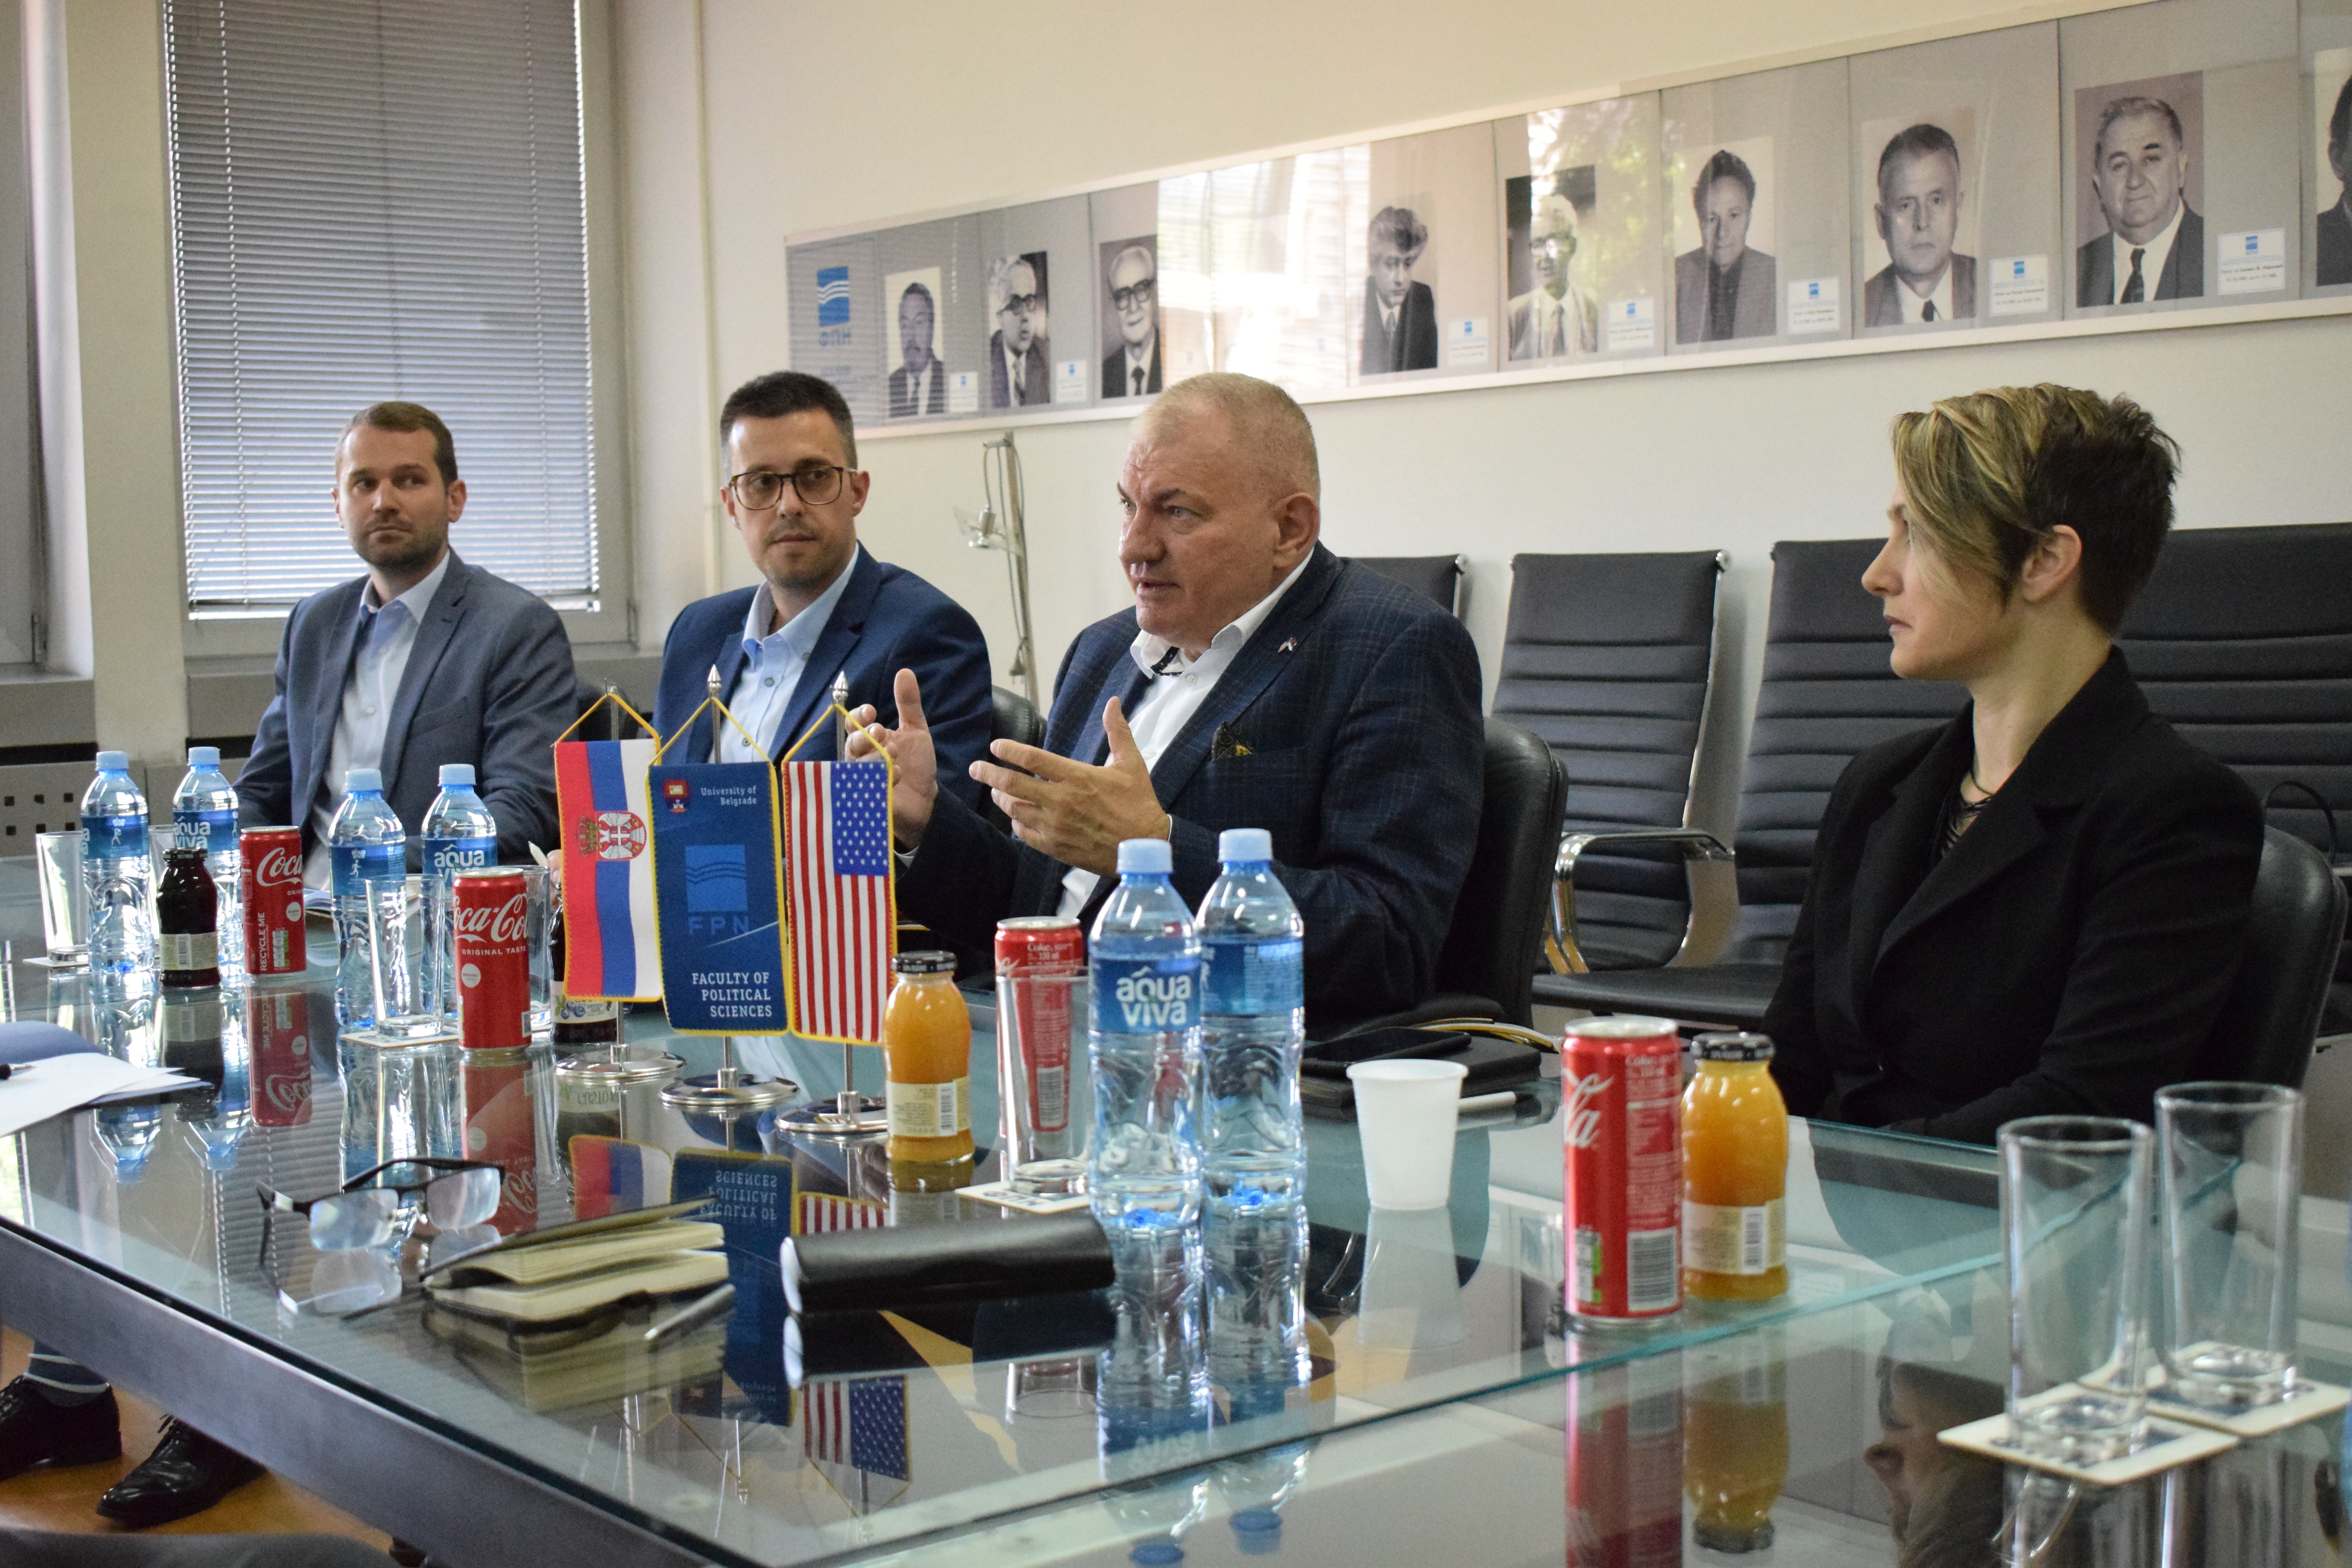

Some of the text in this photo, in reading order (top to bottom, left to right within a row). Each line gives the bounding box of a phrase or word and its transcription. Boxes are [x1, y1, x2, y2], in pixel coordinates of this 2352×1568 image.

[701, 786, 756, 795] University of
[720, 797, 757, 806] Belgrade
[434, 844, 485, 867] aqua
[258, 912, 265, 926] ME
[688, 915, 750, 935] FPN
[506, 946, 526, 954] TASTE
[692, 972, 769, 984] FACULTY OF
[1116, 966, 1191, 1002] aqua
[701, 989, 771, 1001] POLITICAL
[710, 1005, 772, 1018] SCIENCES
[1121, 1001, 1187, 1027] viva
